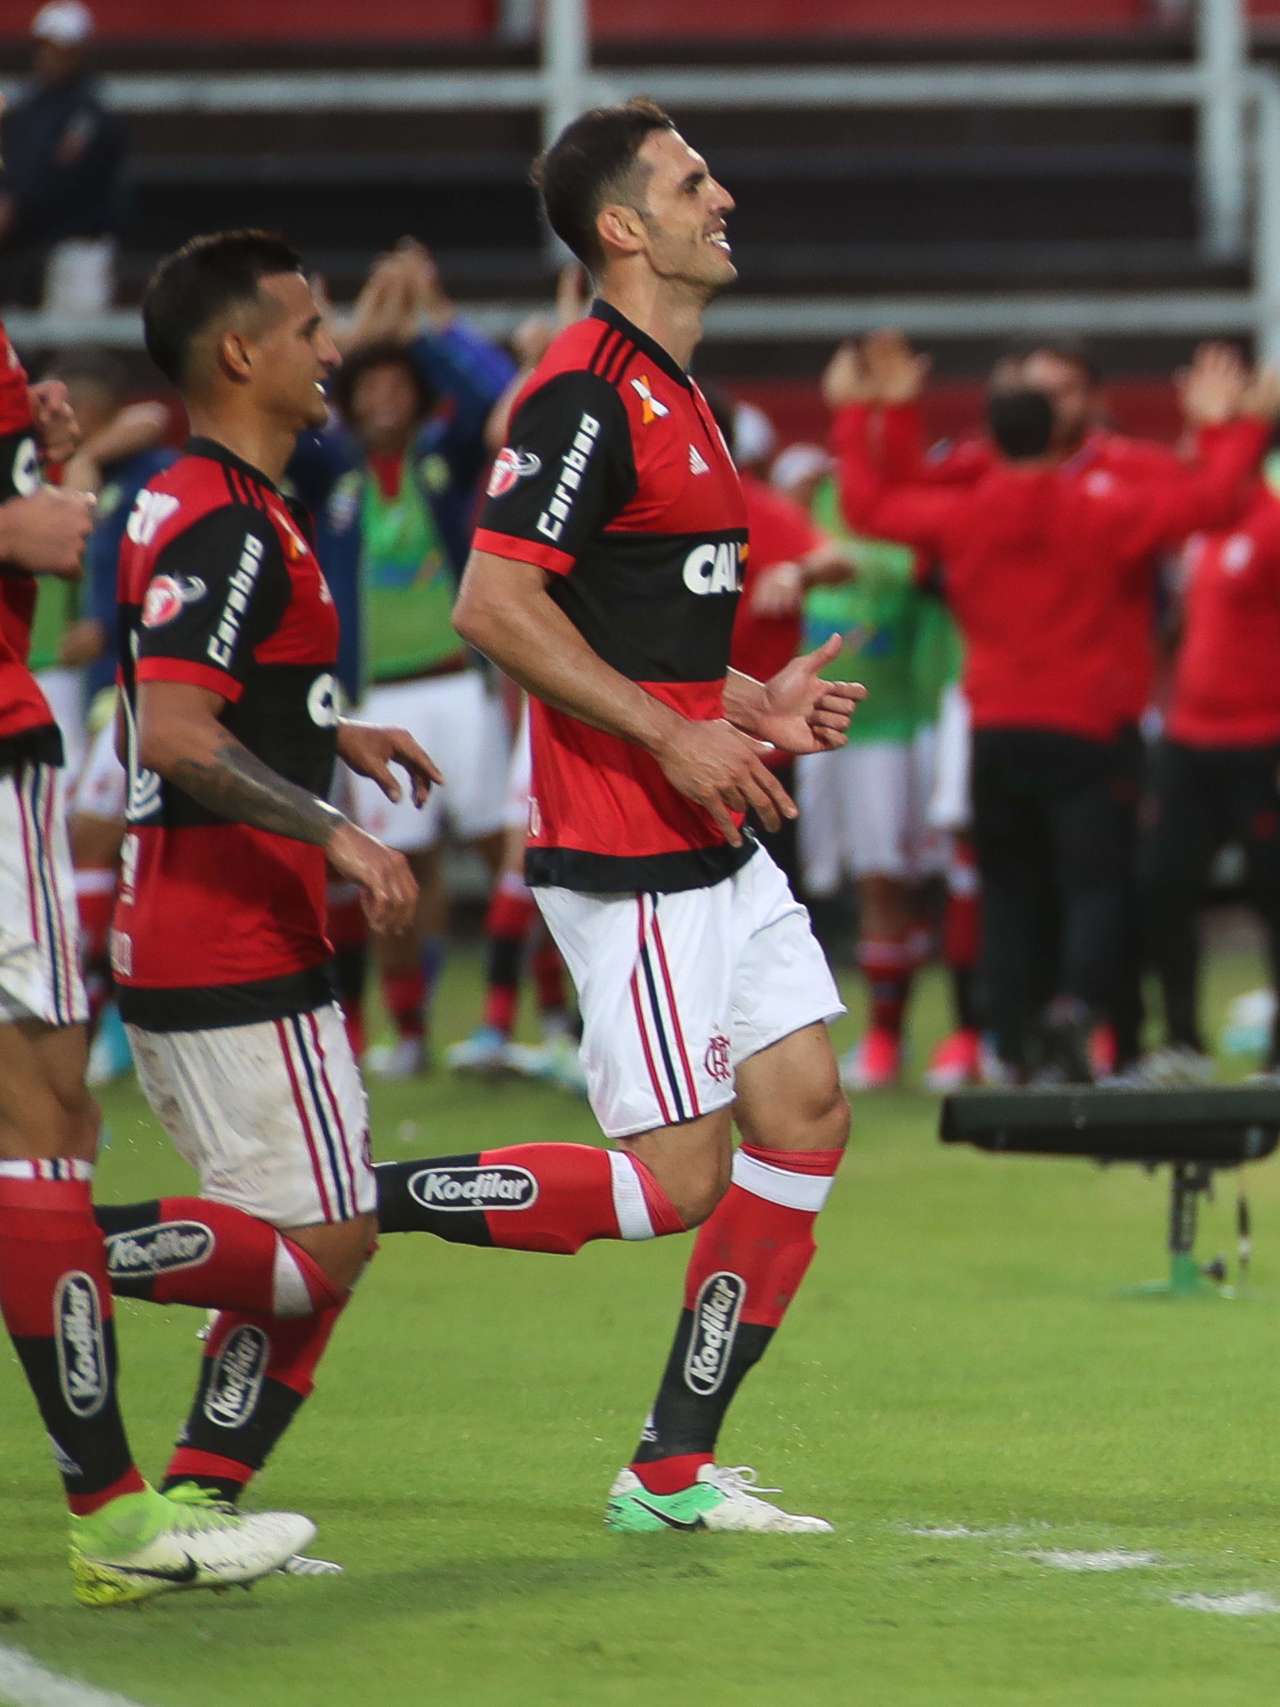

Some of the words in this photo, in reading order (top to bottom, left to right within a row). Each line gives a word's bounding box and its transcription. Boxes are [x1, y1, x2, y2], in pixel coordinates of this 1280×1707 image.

[537, 412, 600, 541] Carabao
[207, 532, 264, 669] Carabao
[424, 1172, 529, 1201] Kodilar
[690, 1277, 737, 1384] Kodilar
